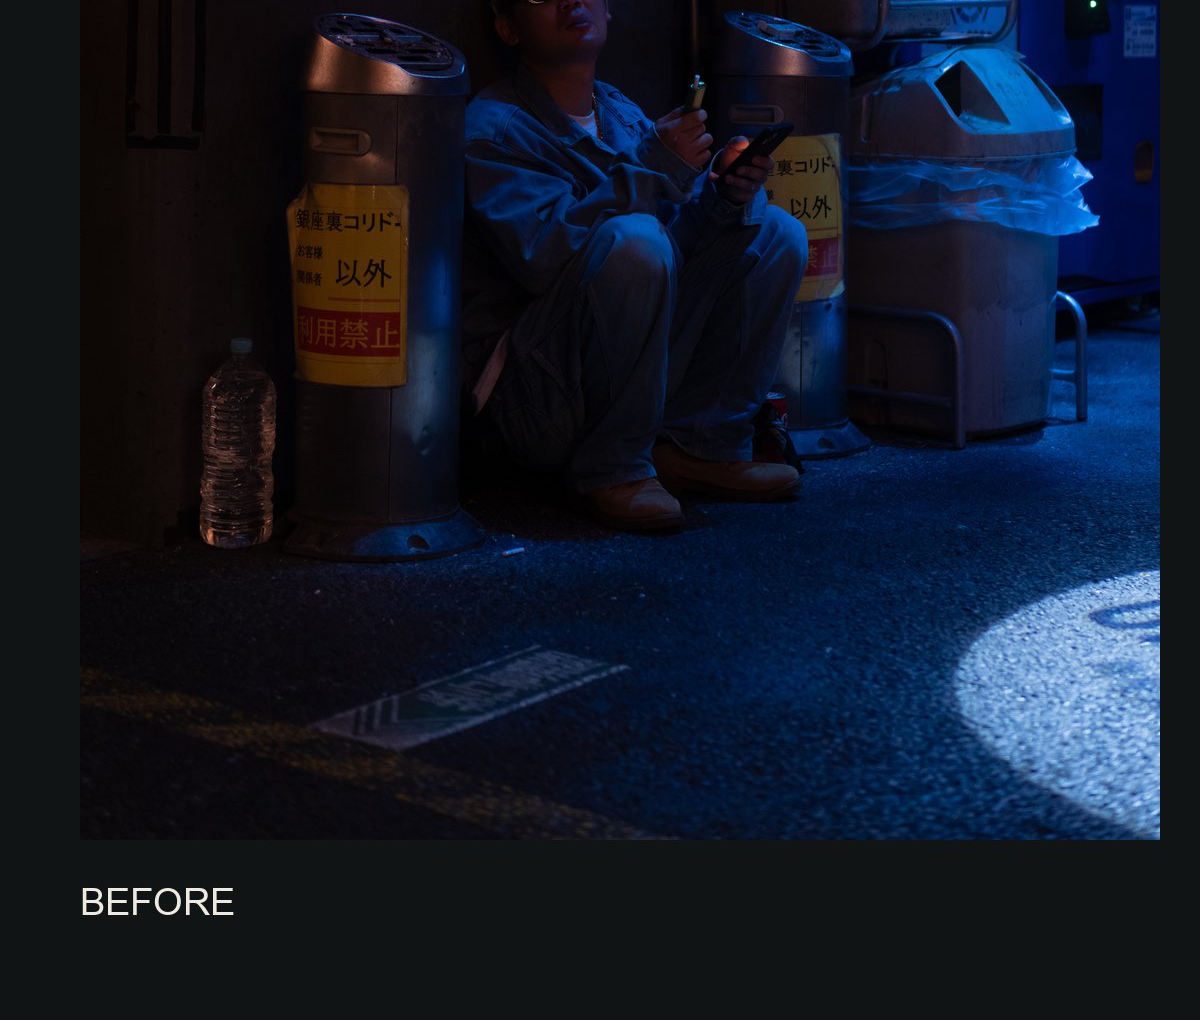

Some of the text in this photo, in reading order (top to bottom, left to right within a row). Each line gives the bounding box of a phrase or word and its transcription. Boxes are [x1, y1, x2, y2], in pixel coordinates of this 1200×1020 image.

[790, 195, 832, 219] 以外
[336, 259, 392, 287] 以外
[299, 314, 400, 349] 利用禁止
